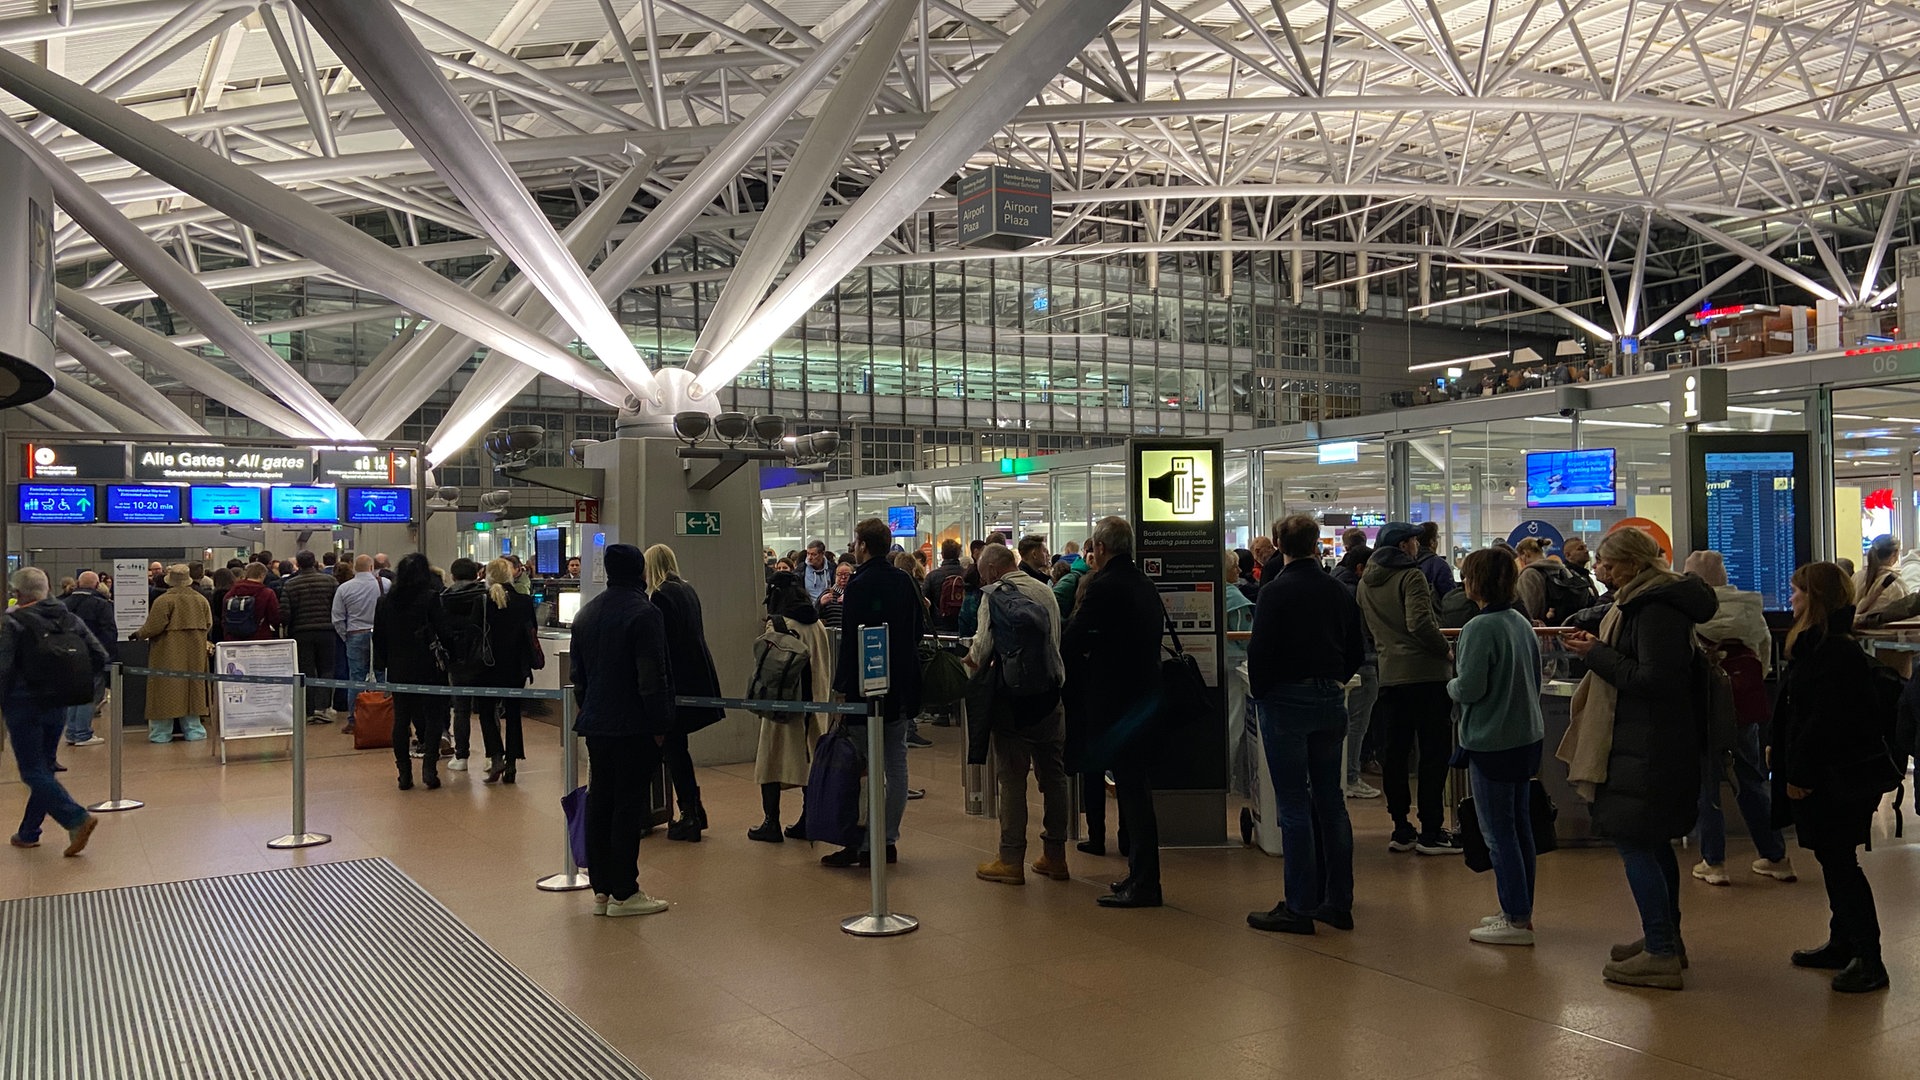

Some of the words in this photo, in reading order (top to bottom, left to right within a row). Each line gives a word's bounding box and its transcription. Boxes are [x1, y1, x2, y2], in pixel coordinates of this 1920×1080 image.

[1004, 173, 1024, 181] Hamburg
[963, 204, 985, 221] Airport
[1004, 200, 1038, 214] Airport
[1004, 214, 1029, 226] Plaza
[963, 221, 979, 234] Plaza
[1873, 354, 1898, 373] 06
[1280, 428, 1292, 440] 07
[142, 452, 174, 467] Alle
[178, 452, 225, 467] Gates
[237, 454, 260, 468] All
[262, 457, 304, 471] gates
